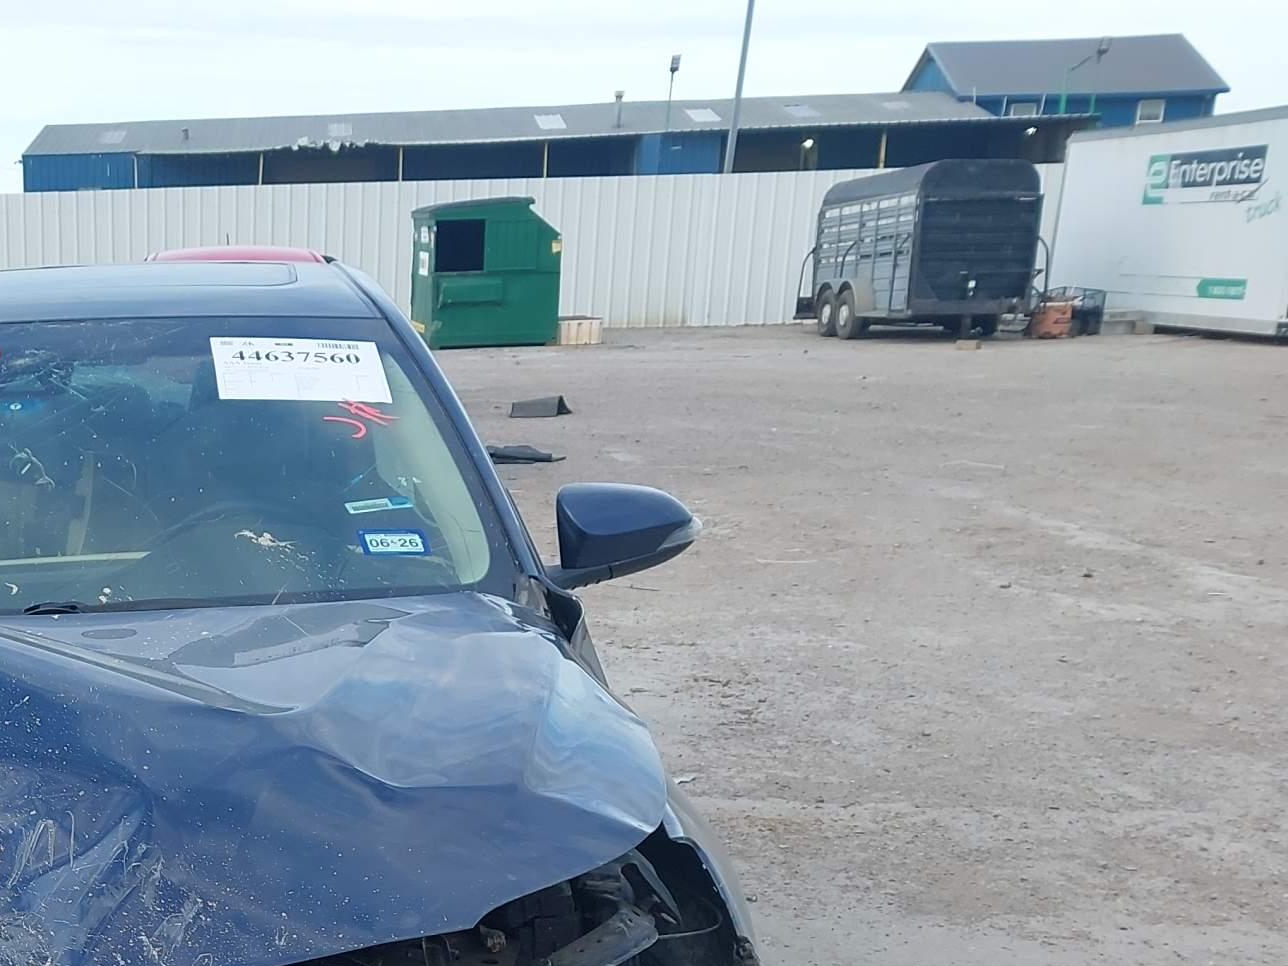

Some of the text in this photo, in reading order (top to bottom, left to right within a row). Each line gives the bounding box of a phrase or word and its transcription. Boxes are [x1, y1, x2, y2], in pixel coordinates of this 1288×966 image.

[1168, 152, 1263, 187] Enterprise
[231, 350, 361, 364] 44637560
[369, 538, 419, 548] 06 26
